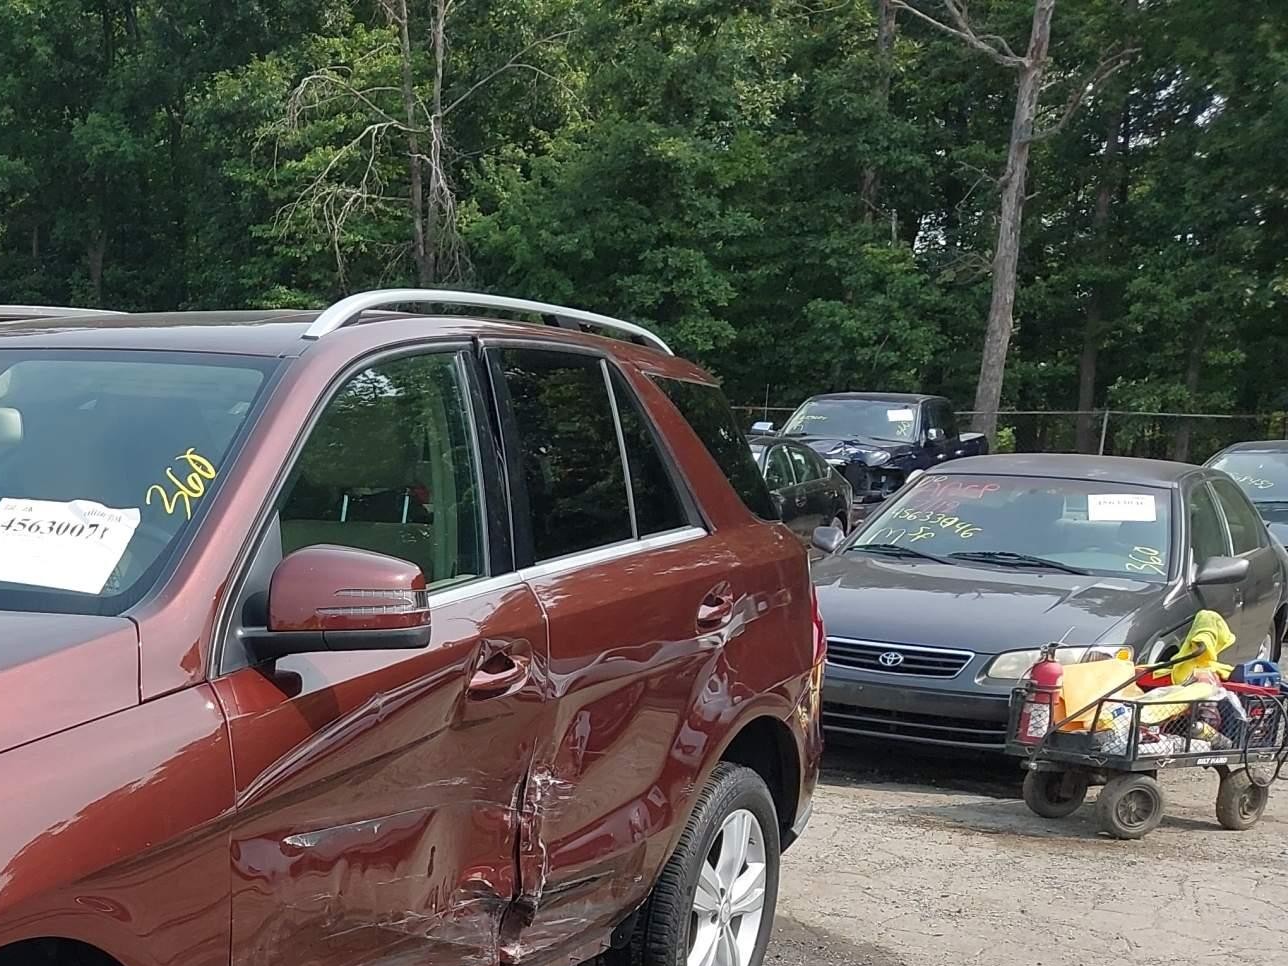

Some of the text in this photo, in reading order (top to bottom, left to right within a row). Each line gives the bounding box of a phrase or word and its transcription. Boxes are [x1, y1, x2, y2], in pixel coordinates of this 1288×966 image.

[146, 448, 216, 521] 360
[0, 517, 111, 540] 45630071
[1125, 546, 1167, 576] 360
